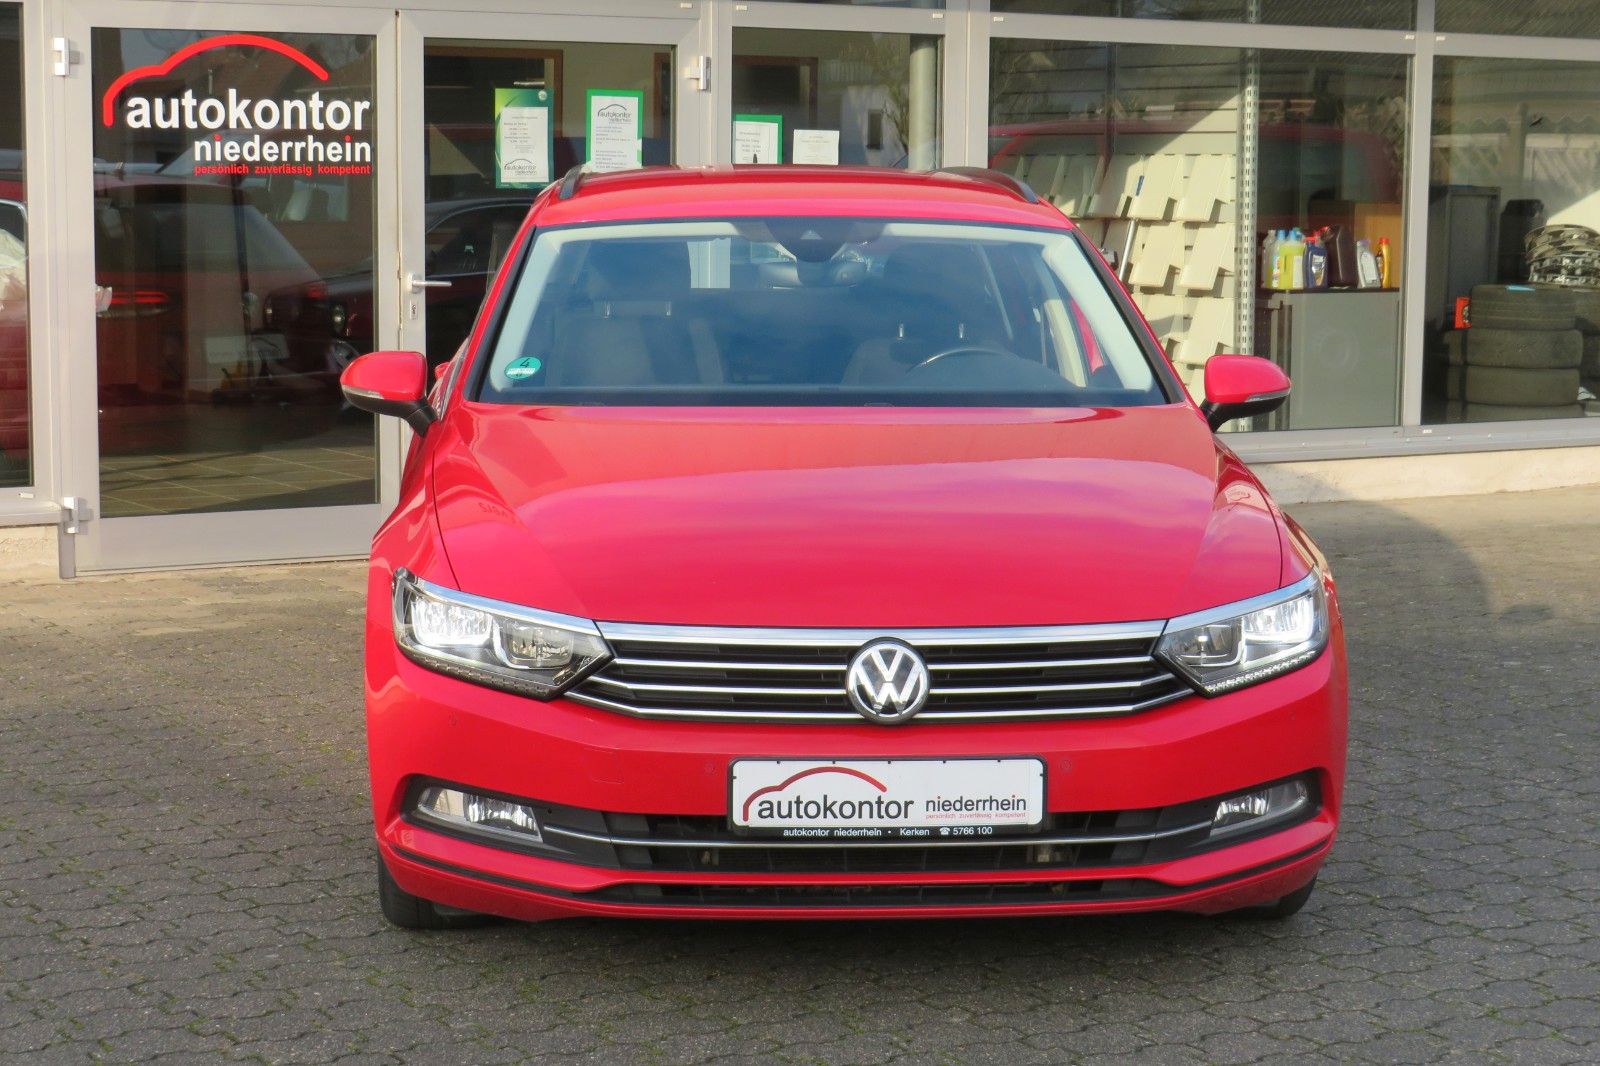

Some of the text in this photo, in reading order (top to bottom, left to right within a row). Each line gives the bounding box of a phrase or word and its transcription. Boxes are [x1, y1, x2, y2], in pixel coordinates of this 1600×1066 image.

[126, 88, 370, 130] autokontor
[194, 134, 371, 162] niederrhein
[194, 164, 371, 176] persönlich zuverlässig kompetent
[519, 357, 531, 368] 4
[757, 794, 1026, 819] autokontor niederrhein
[783, 827, 993, 837] autokontor niederrhein Kerken 5766 100
